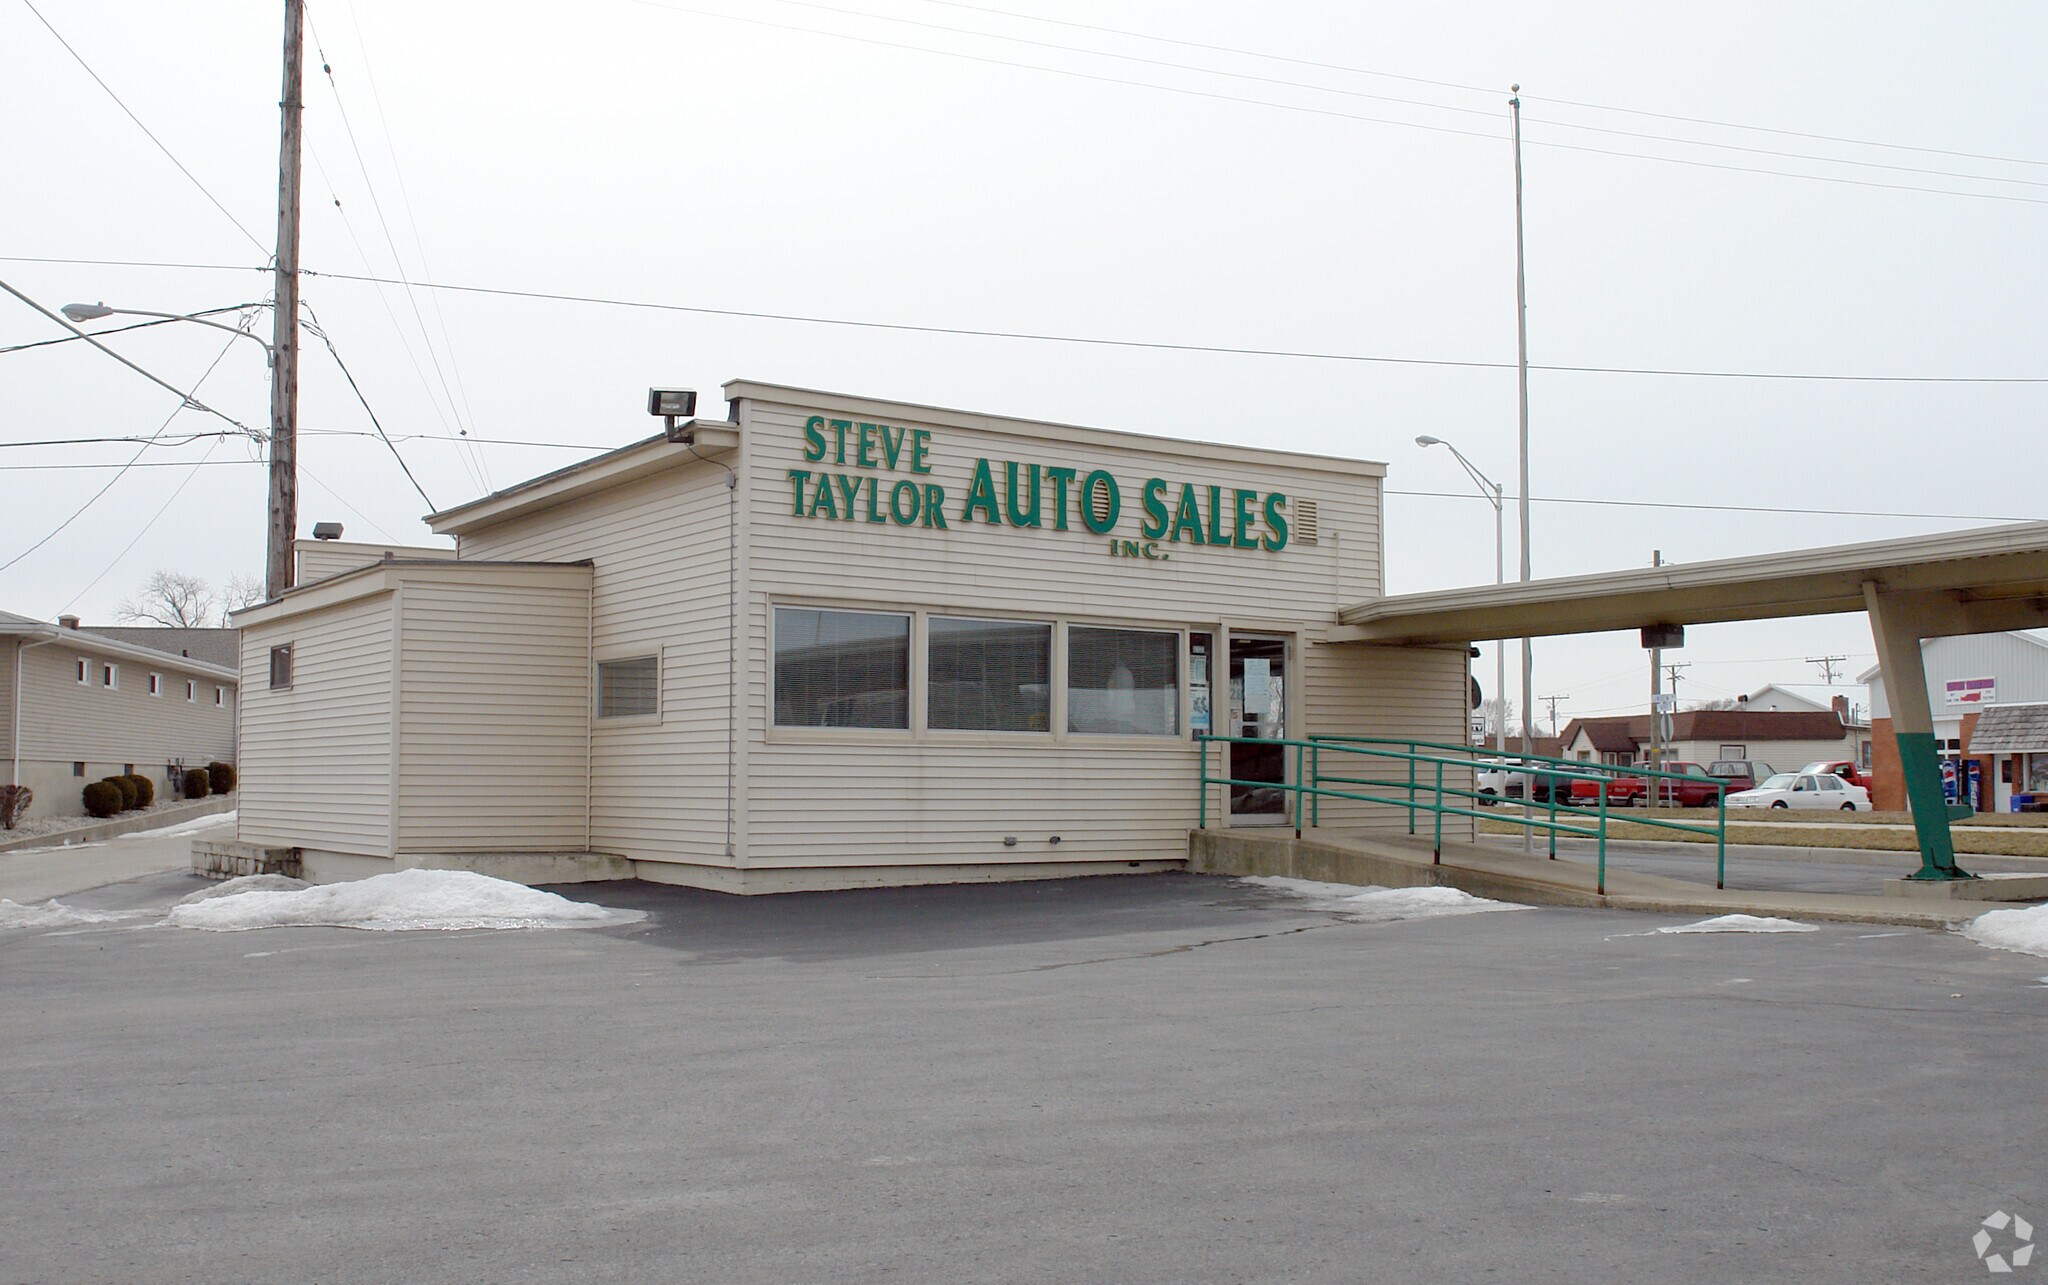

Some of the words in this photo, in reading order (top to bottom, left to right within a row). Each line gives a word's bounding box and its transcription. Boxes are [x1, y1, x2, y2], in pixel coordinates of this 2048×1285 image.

[803, 414, 933, 475] STEVE
[787, 468, 949, 530] TAYLOR
[962, 457, 1122, 535] AUTO
[1142, 476, 1290, 553] SALES
[1111, 538, 1170, 562] INC.
